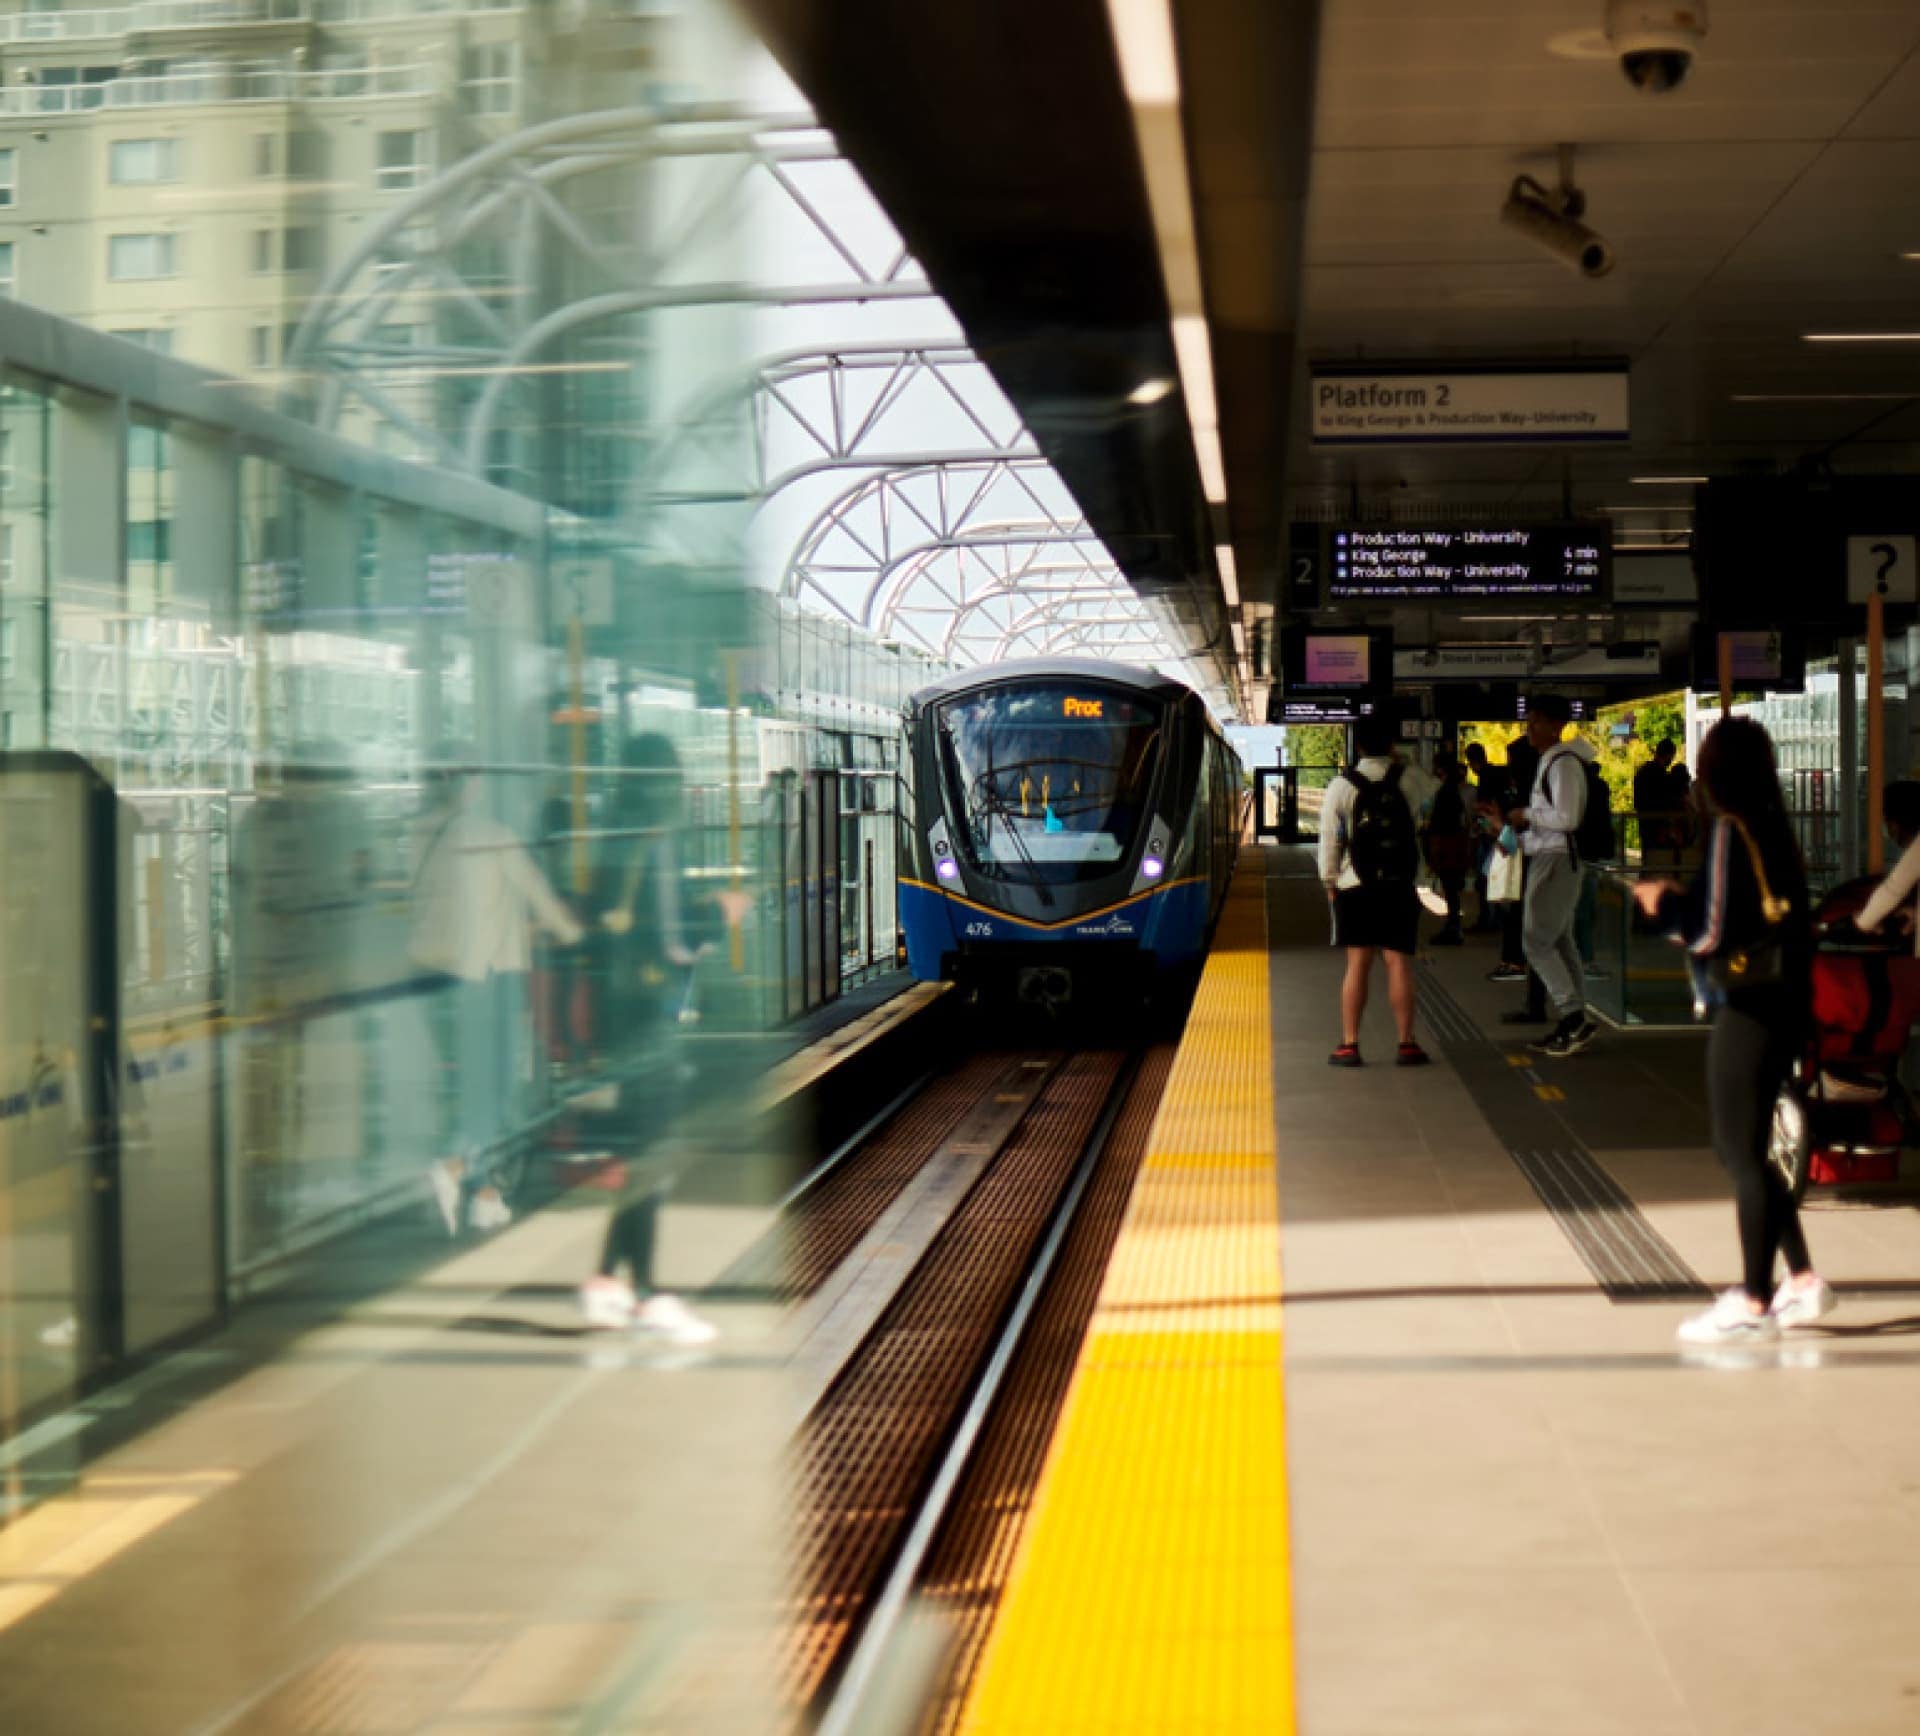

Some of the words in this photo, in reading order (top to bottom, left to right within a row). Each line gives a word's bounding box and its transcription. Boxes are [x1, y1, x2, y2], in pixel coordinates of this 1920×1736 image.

[1320, 383, 1426, 408] Platform
[1436, 384, 1450, 406] 2
[1337, 414, 1363, 428] King
[1368, 414, 1411, 428] George
[1430, 412, 1495, 425] Production
[1352, 531, 1421, 545] Production
[1423, 532, 1451, 547] Way
[1464, 530, 1530, 546] University
[1352, 549, 1378, 564] King
[1382, 549, 1426, 563] George
[1564, 546, 1573, 558] 4
[1574, 545, 1598, 559] min
[1296, 557, 1313, 584] 2
[1352, 564, 1421, 578] Production
[1423, 564, 1451, 580] Way
[1464, 563, 1530, 579] University
[1564, 563, 1573, 576] 7
[1574, 563, 1598, 576] min
[965, 922, 993, 936] 476
